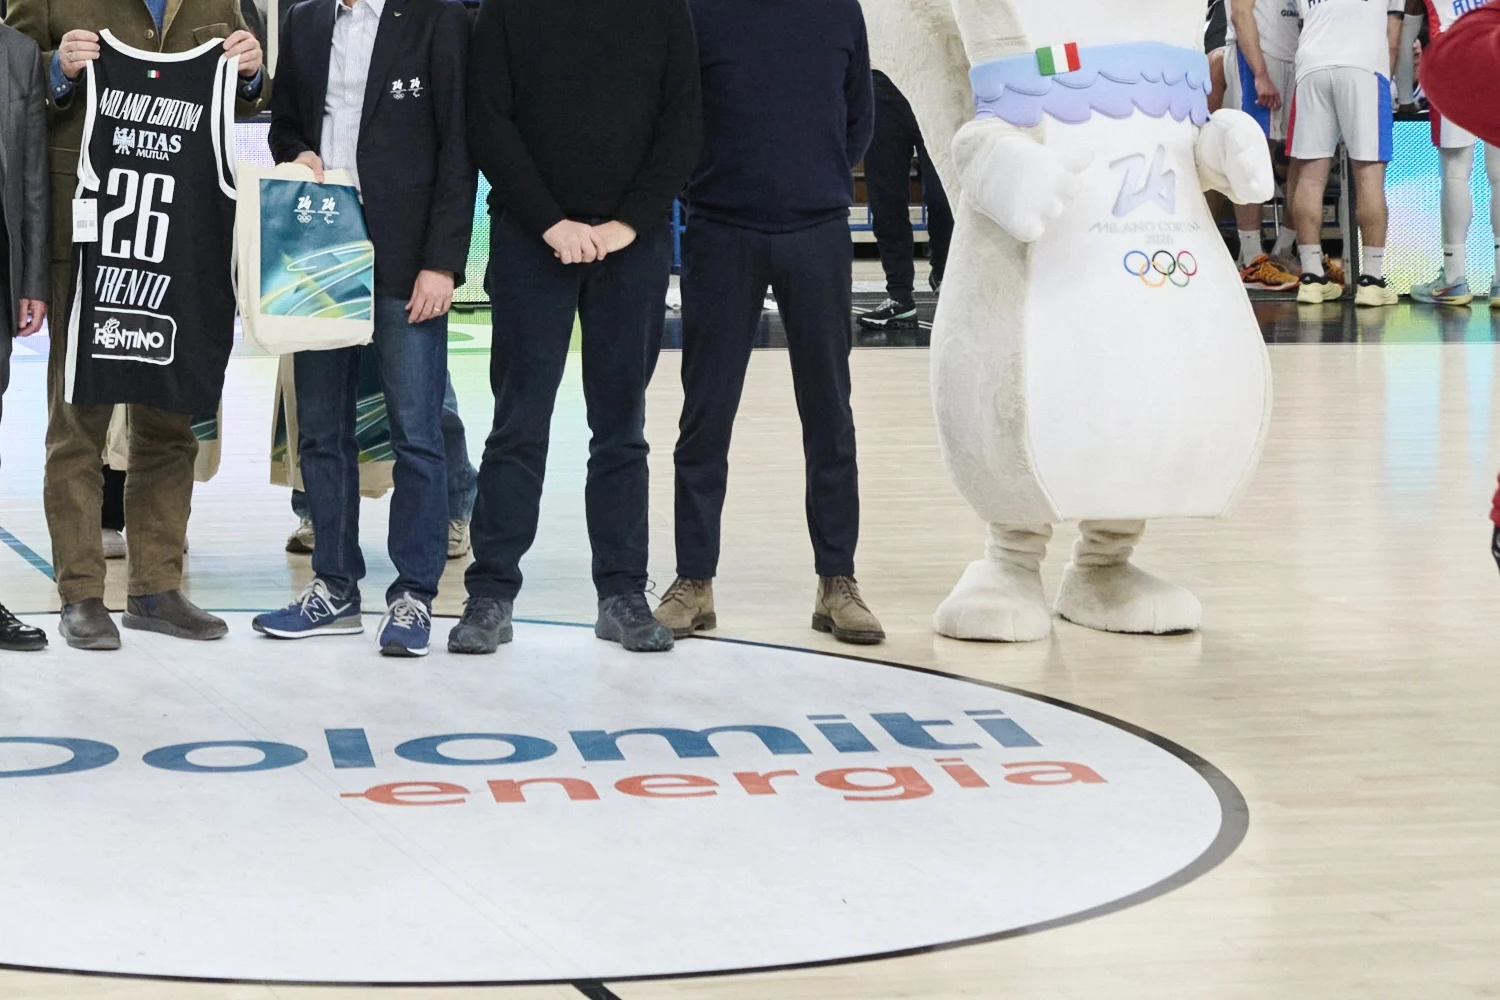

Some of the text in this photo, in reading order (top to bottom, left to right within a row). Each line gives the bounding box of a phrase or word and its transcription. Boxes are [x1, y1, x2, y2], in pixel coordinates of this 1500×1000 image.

[99, 88, 204, 133] MILANO CORTINA
[136, 129, 182, 154] ITAS
[136, 148, 170, 161] MUTUA
[101, 167, 176, 264] 26
[1088, 221, 1155, 234] MILANO
[94, 265, 171, 310] TRENTO
[339, 758, 1109, 808] energia
